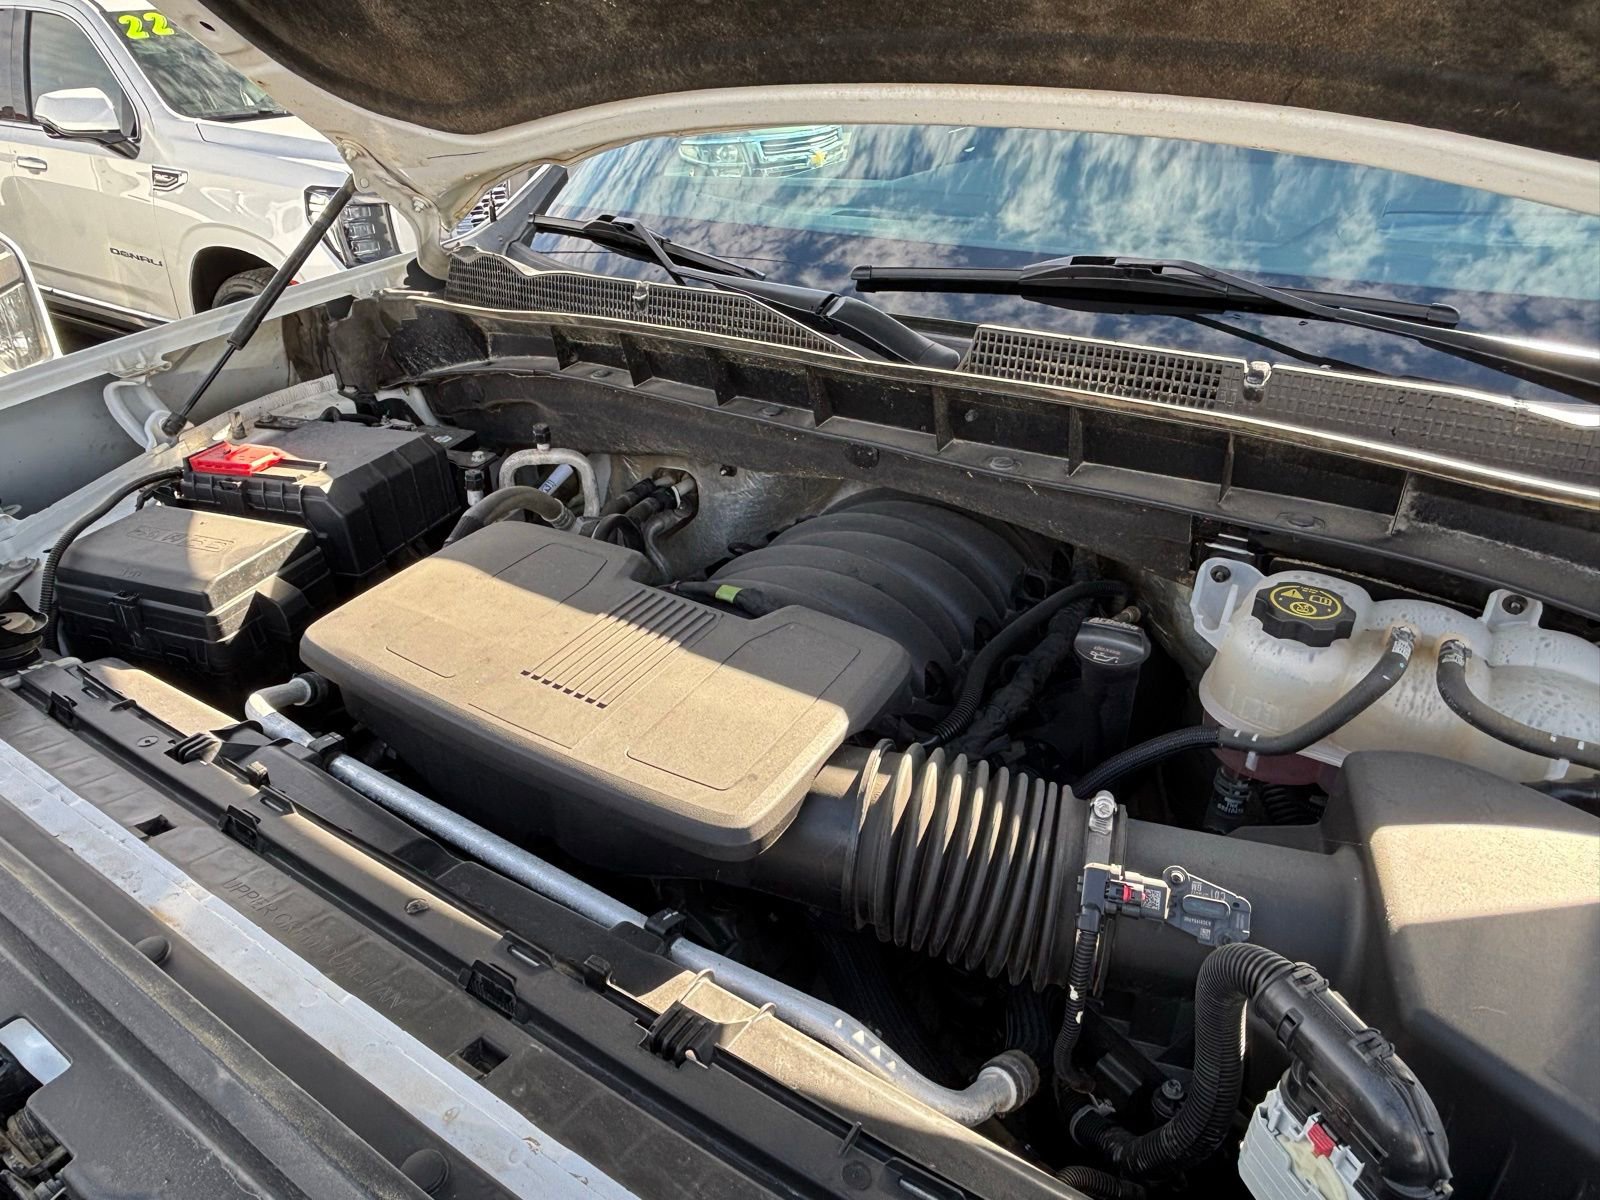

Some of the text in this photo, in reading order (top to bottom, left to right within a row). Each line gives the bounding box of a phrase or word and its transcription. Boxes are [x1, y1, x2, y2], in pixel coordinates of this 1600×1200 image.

[118, 12, 175, 39] 22
[109, 247, 163, 267] DENALI
[222, 877, 278, 917] UPPER
